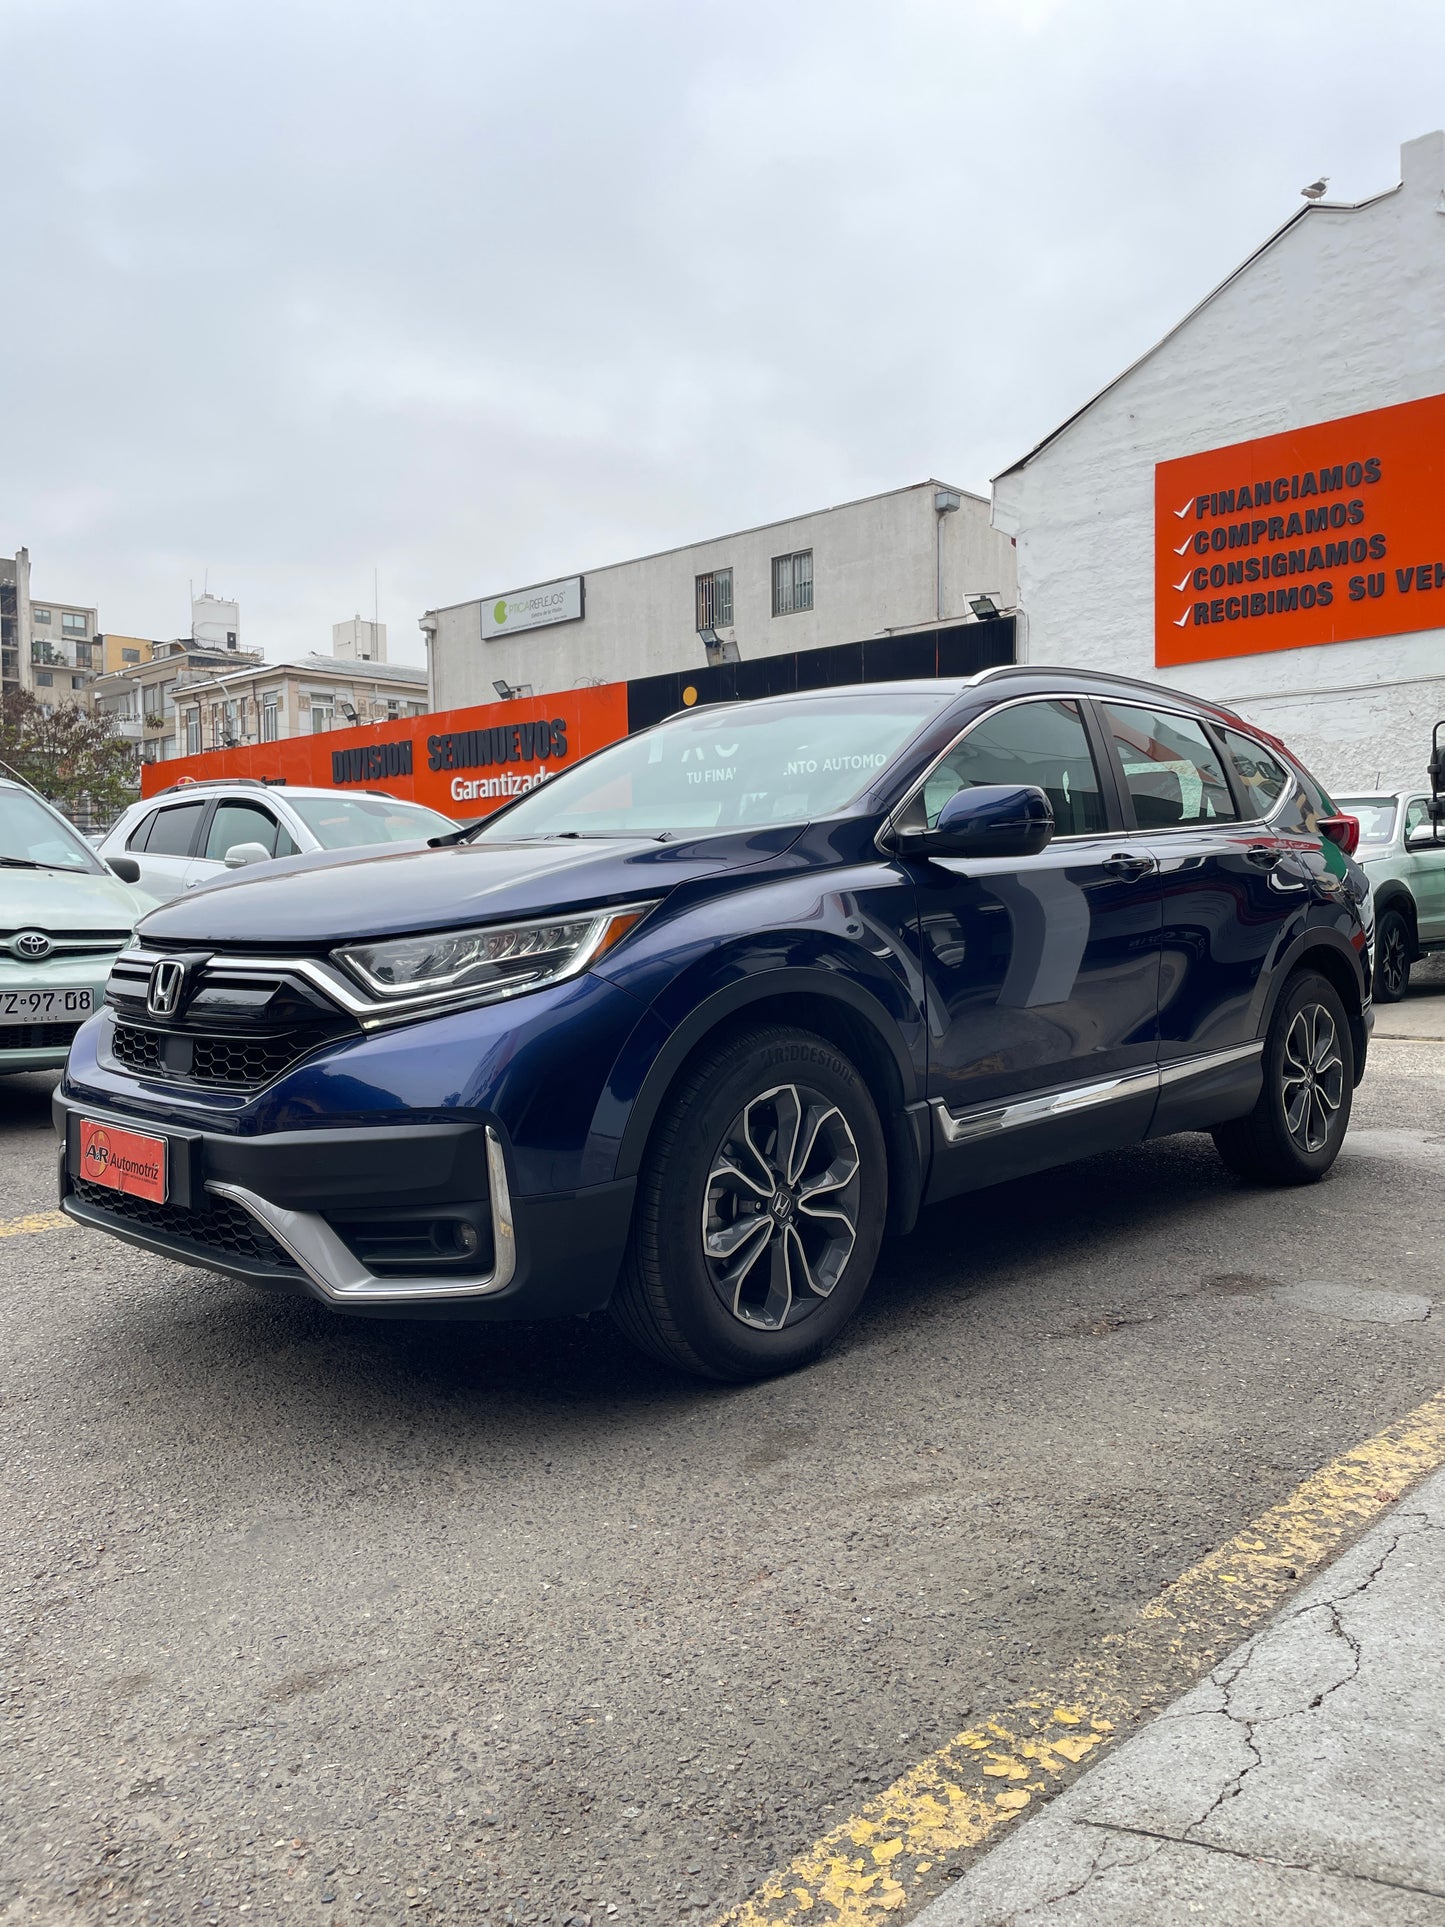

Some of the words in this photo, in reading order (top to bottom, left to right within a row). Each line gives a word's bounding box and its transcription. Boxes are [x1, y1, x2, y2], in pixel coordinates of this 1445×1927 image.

[1195, 457, 1382, 519] FINANCIAMOS
[1194, 499, 1365, 554] COMPRAMOS
[1193, 533, 1387, 590] CONSIGNAMOS
[1194, 581, 1333, 626] RECIBIMOS
[1349, 572, 1385, 601] SU
[332, 740, 413, 783] DIVISION
[427, 718, 568, 771] SEMINUEVOS
[686, 771, 702, 784] TU
[704, 768, 737, 783] FINA
[822, 753, 887, 772] AUTOMO
